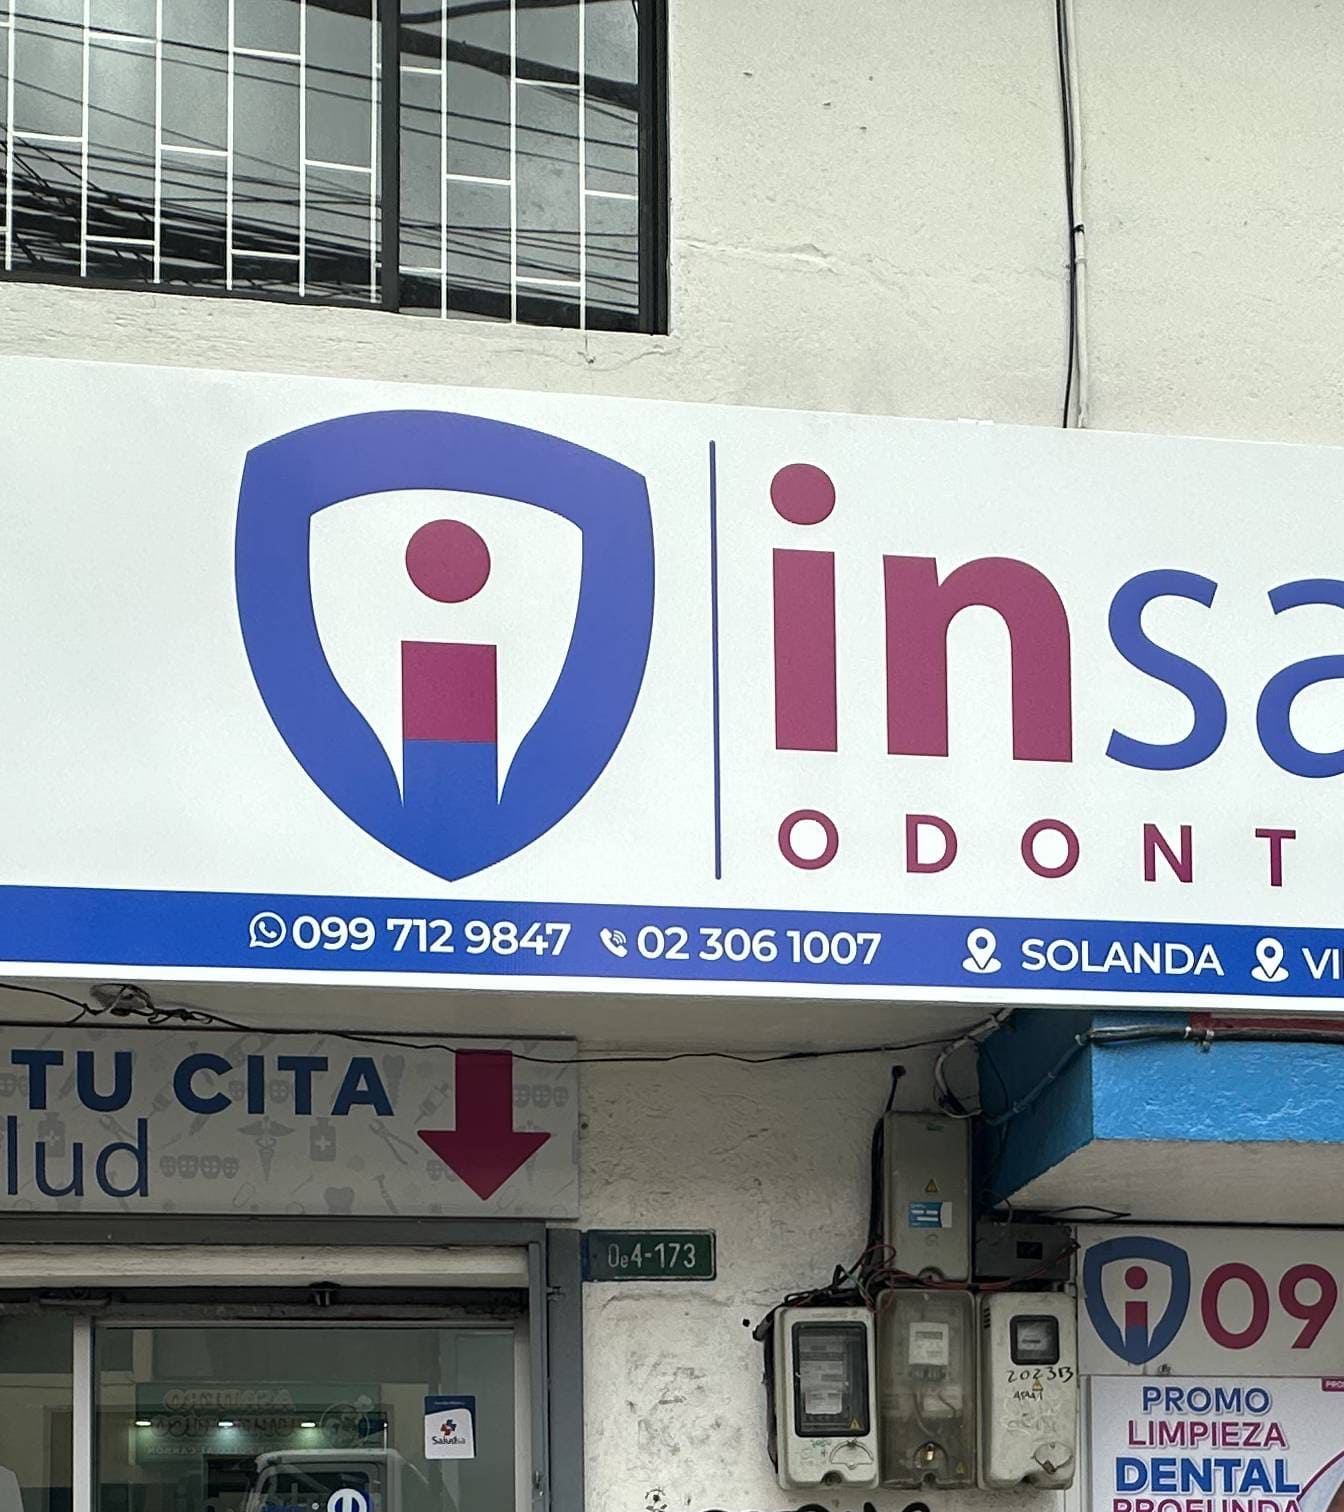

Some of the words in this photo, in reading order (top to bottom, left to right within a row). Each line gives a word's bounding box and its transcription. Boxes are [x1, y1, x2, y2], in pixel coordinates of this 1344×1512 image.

[292, 915, 376, 952] 099
[387, 917, 456, 955] 712
[466, 921, 572, 958] 9847
[636, 928, 691, 961] 02
[700, 930, 778, 964] 306
[791, 932, 882, 966] 1007
[1021, 939, 1224, 977] SOLANDA
[10, 1048, 134, 1113] TU
[172, 1053, 395, 1117] CITA
[1142, 1386, 1272, 1413] PROMO
[1128, 1421, 1288, 1448] LIMPIEZA
[1115, 1457, 1301, 1494] DENTAL
